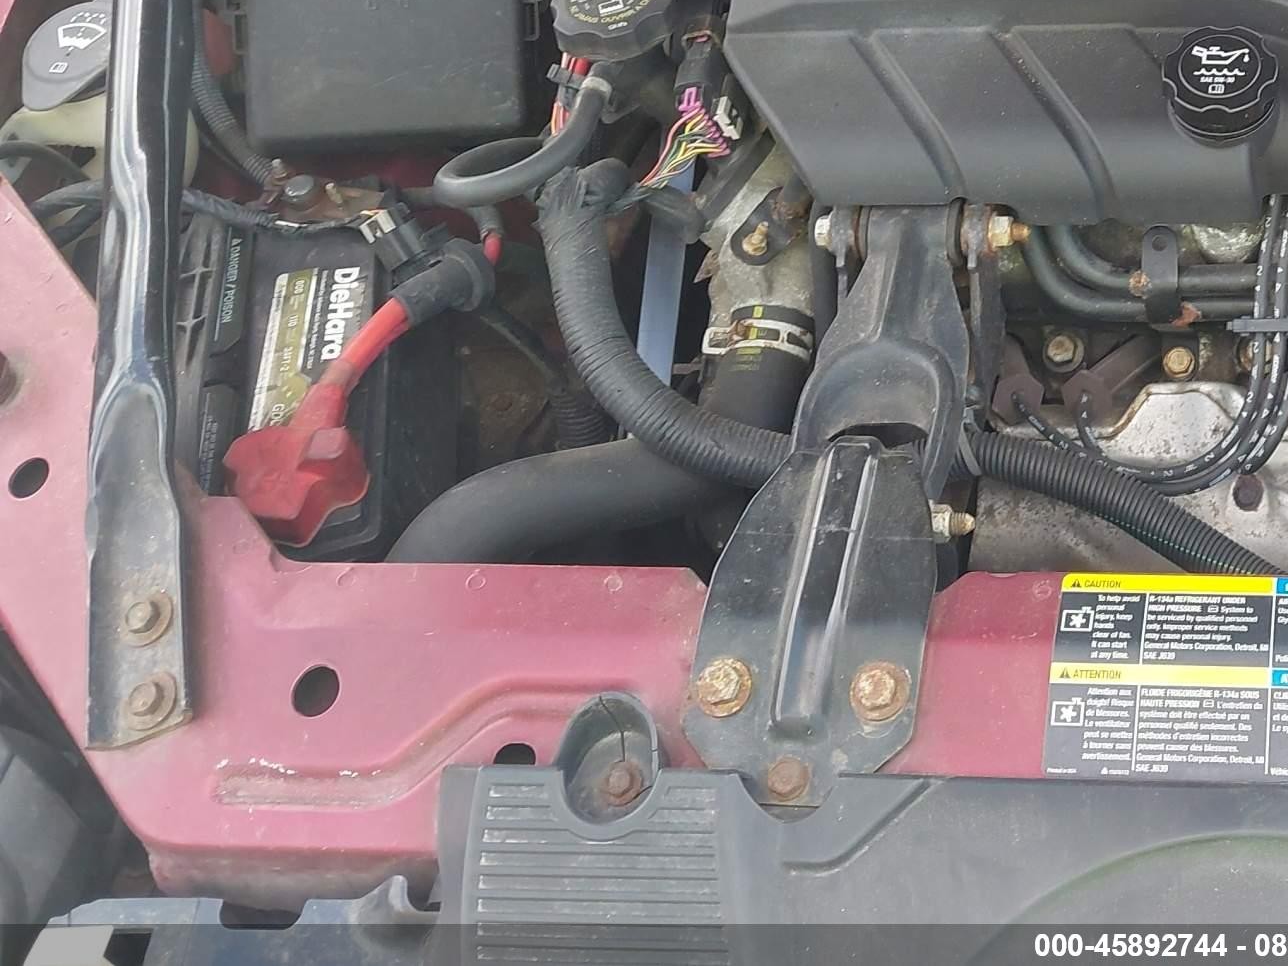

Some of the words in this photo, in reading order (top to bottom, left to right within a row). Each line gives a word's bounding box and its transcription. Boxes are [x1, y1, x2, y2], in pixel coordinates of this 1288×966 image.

[1214, 76, 1236, 84] 5W-30
[226, 246, 240, 282] DANGER
[220, 290, 236, 324] POISON
[1084, 580, 1121, 588] CAUTION
[1106, 594, 1121, 603] help
[1174, 596, 1221, 604] REFRIGERANT
[1116, 613, 1133, 621] keep
[1186, 615, 1195, 623] by
[1195, 615, 1225, 623] qualified
[1181, 633, 1211, 641] personal
[1170, 642, 1194, 650] Motors
[1073, 669, 1121, 679] ATTENTION
